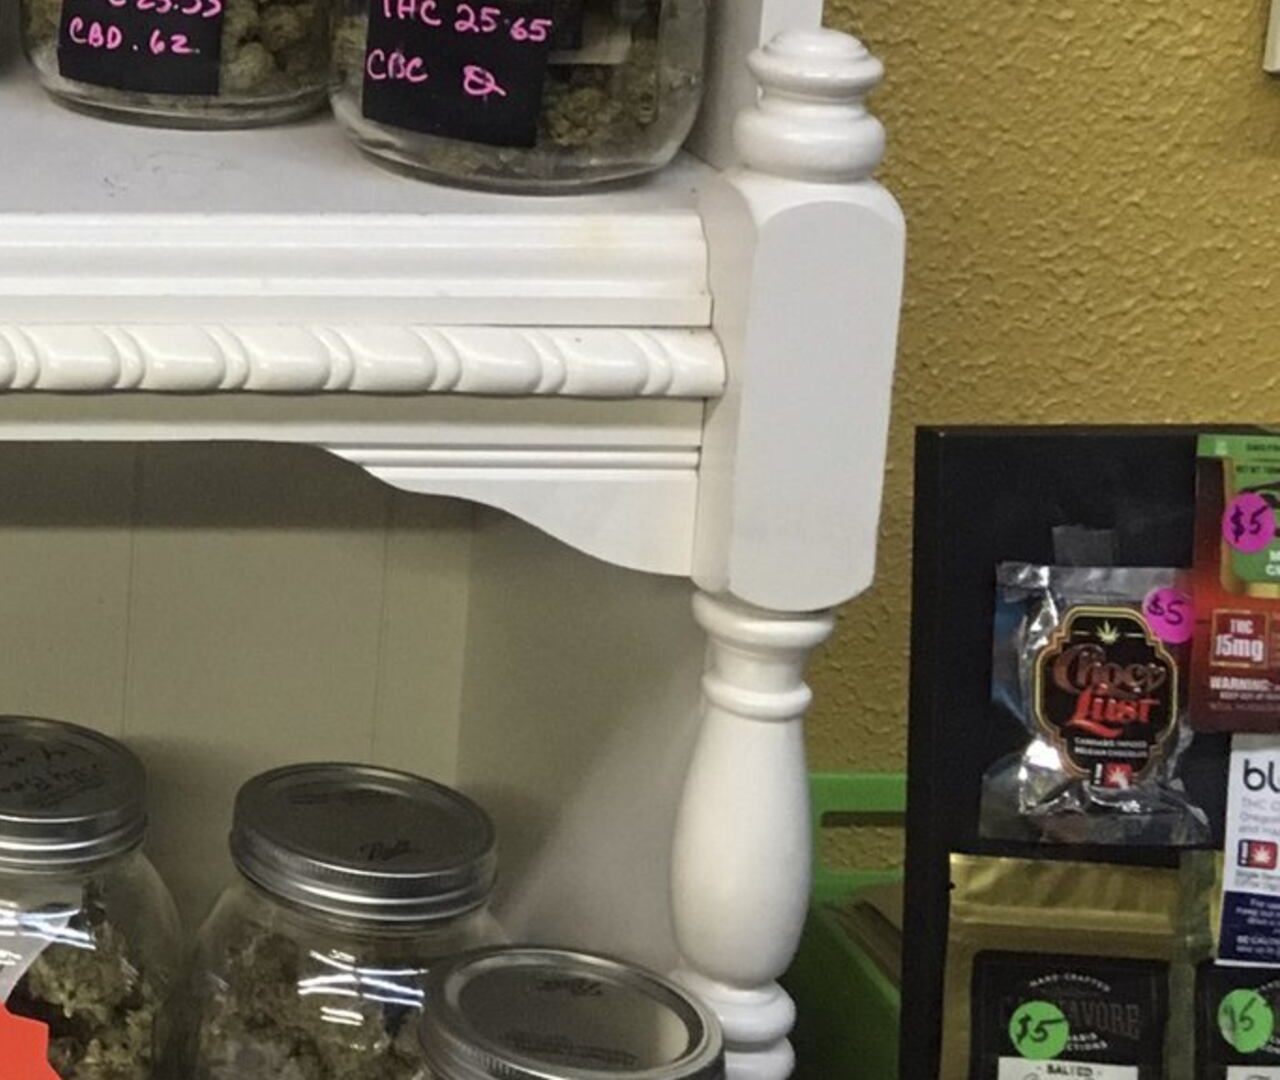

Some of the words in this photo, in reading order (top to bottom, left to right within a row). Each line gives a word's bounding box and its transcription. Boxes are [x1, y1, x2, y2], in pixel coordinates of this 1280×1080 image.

[69, 16, 123, 49] CBD
[1230, 504, 1269, 543] $5
[1147, 598, 1185, 626] $5
[1230, 619, 1253, 634] THC
[1216, 633, 1263, 662] 15mg
